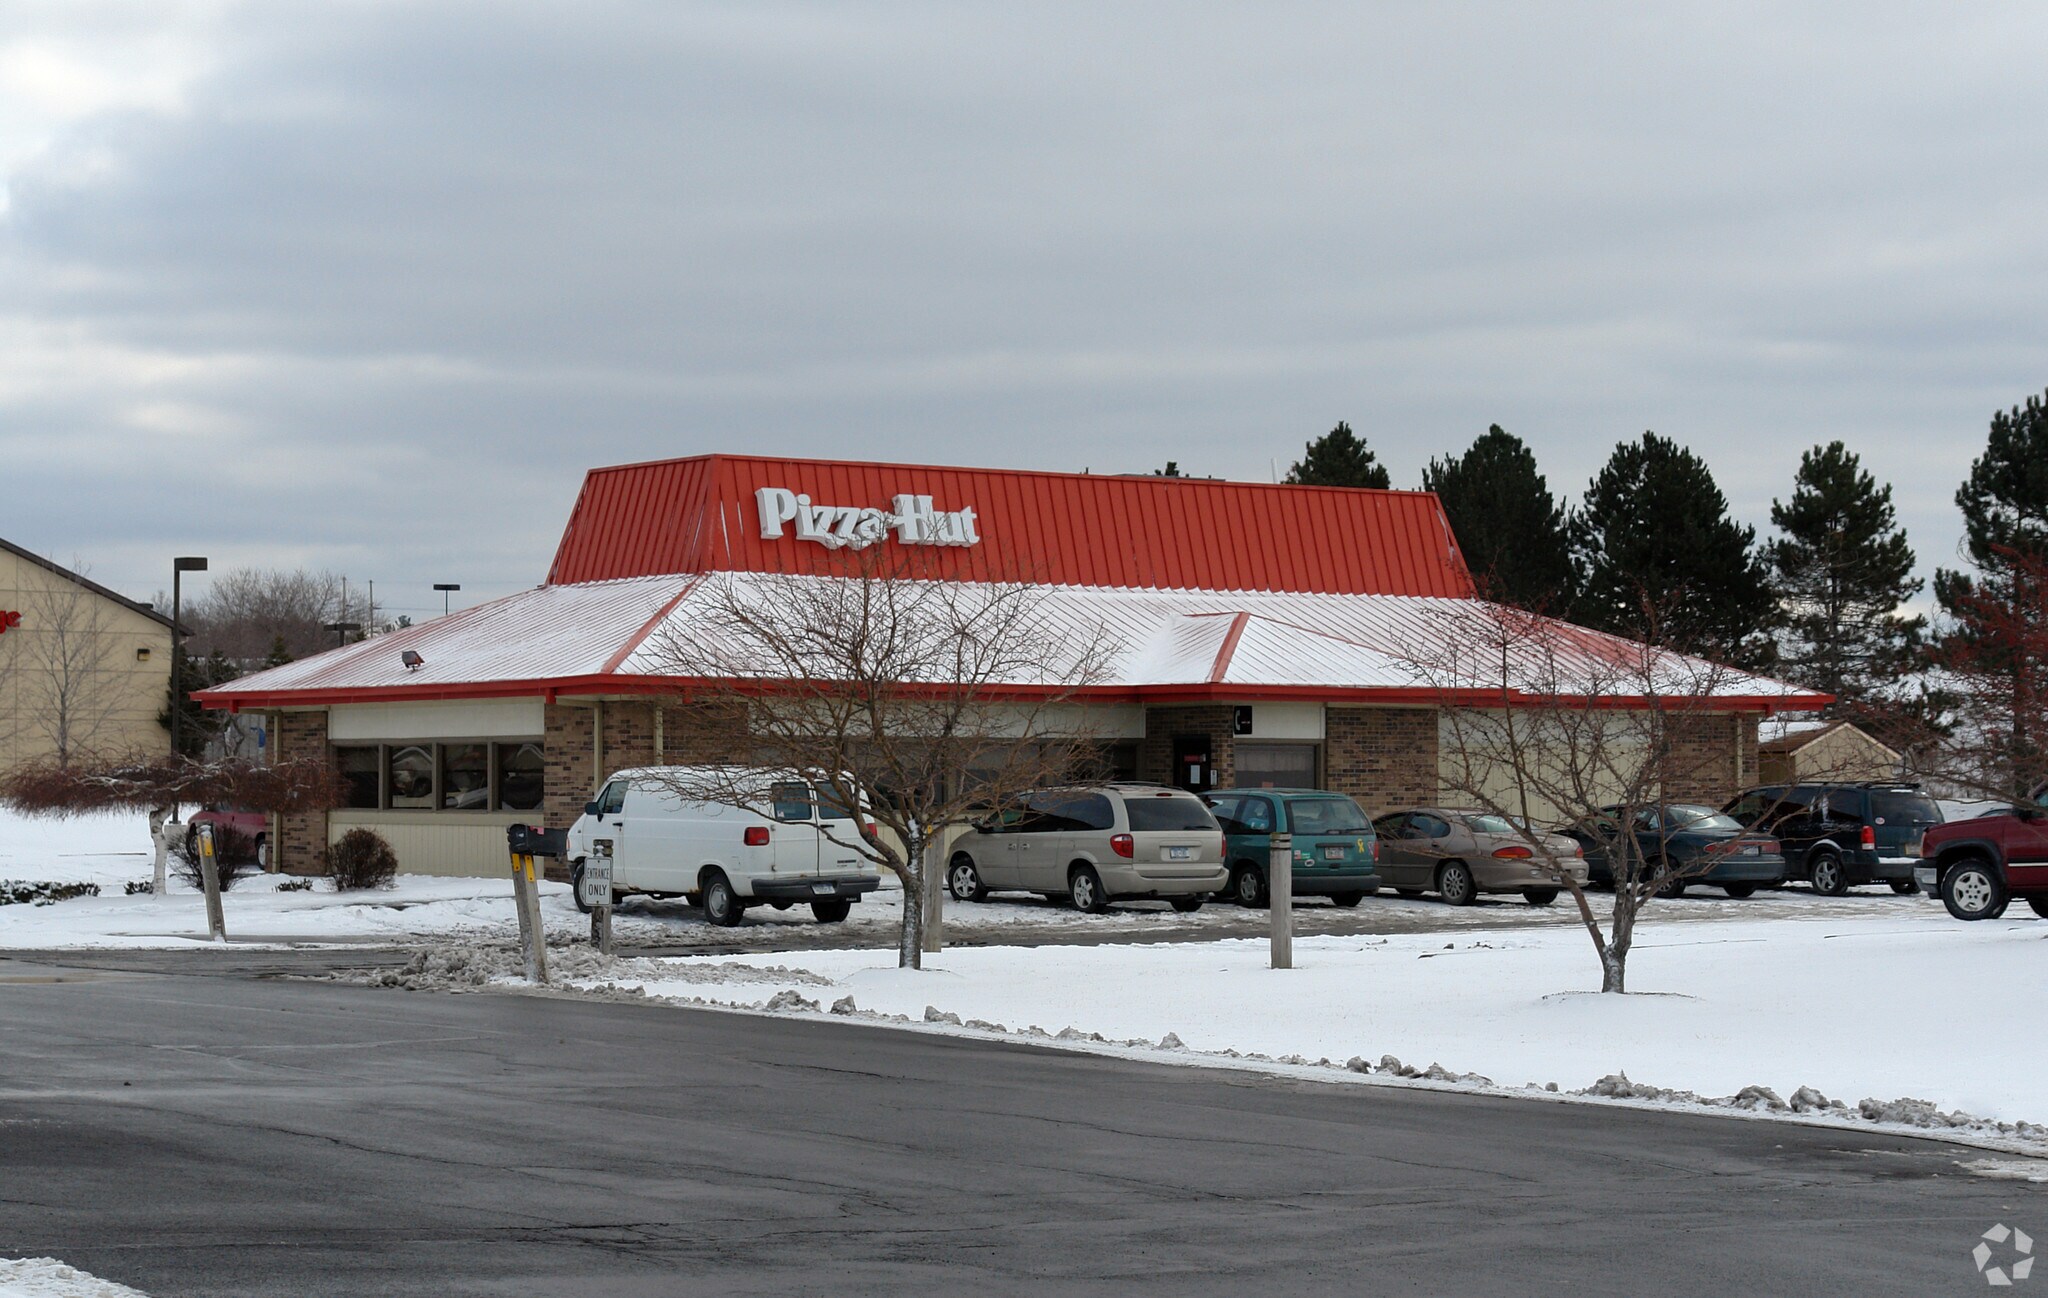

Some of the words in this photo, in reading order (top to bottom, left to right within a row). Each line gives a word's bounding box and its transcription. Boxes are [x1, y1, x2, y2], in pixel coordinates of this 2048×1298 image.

[755, 487, 889, 550] Pizza
[890, 494, 980, 547] Hut
[587, 867, 610, 880] ENTRANCE
[588, 884, 607, 896] ONLY
